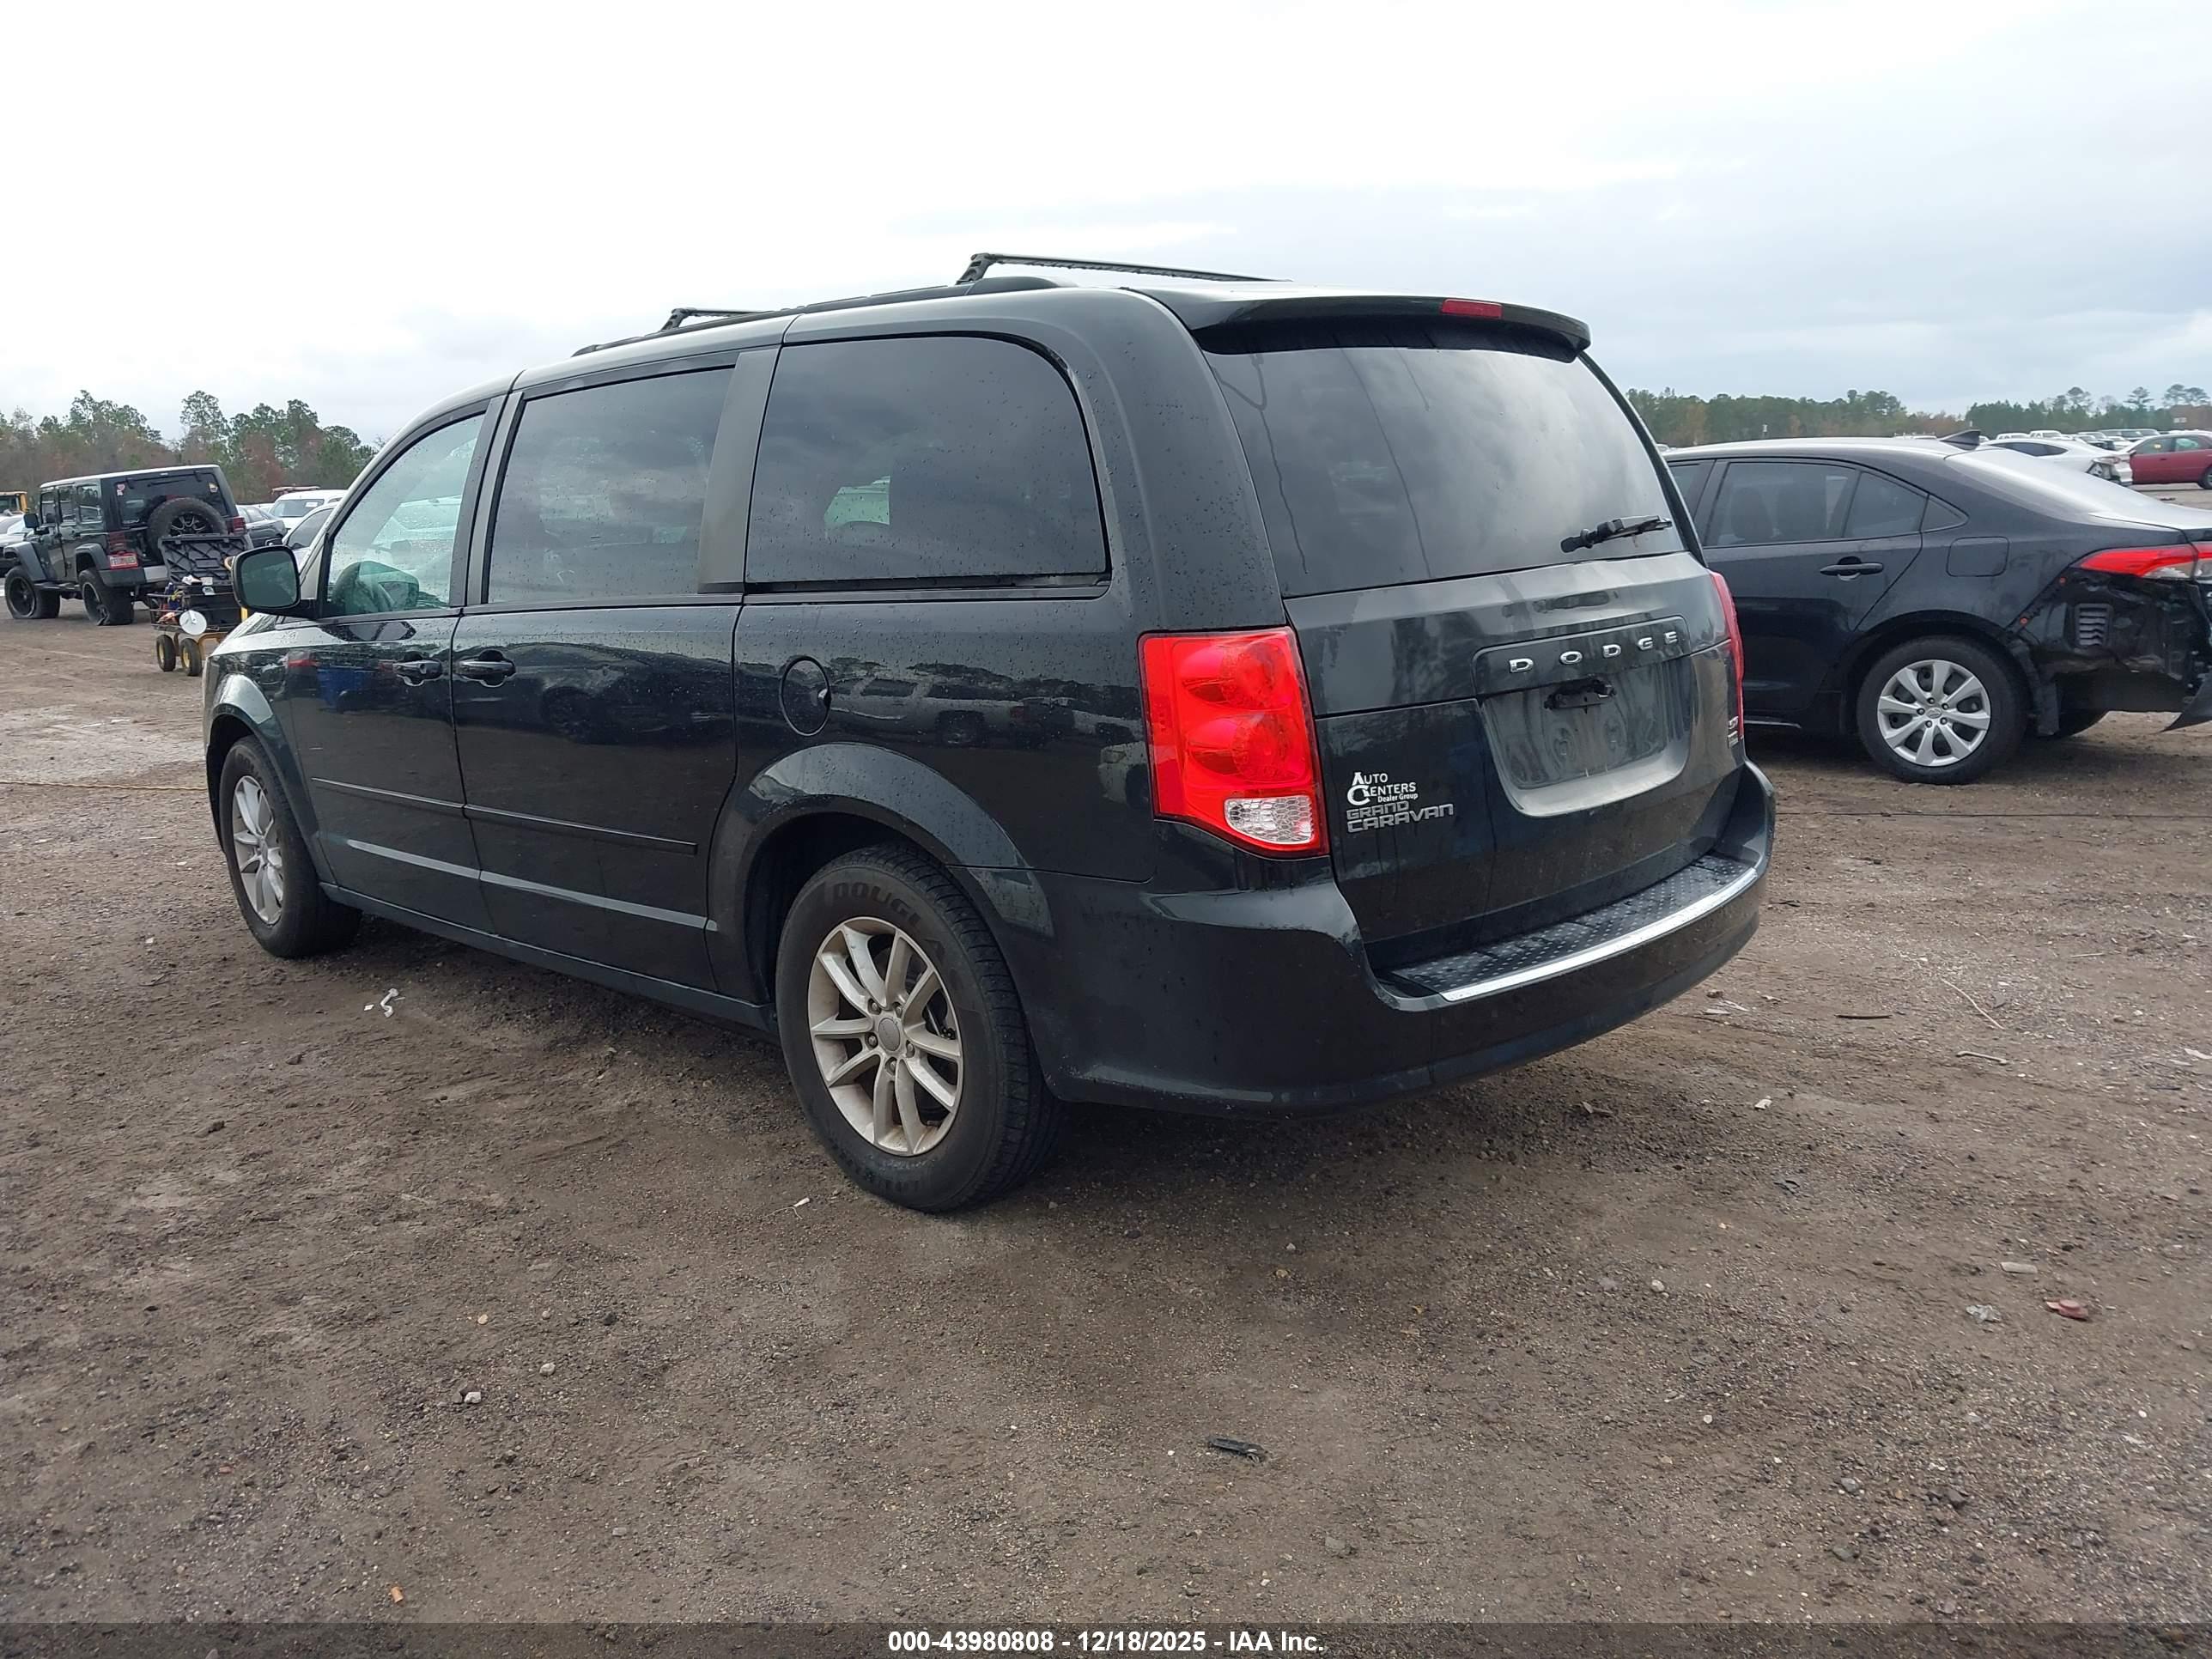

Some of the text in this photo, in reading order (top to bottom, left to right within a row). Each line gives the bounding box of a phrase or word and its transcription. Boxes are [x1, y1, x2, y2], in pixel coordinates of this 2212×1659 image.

[1508, 630, 1679, 674] DODGE
[1346, 800, 1409, 821] GRAND
[1377, 794, 1398, 803] Dealer
[1346, 803, 1454, 833] CARAVAN
